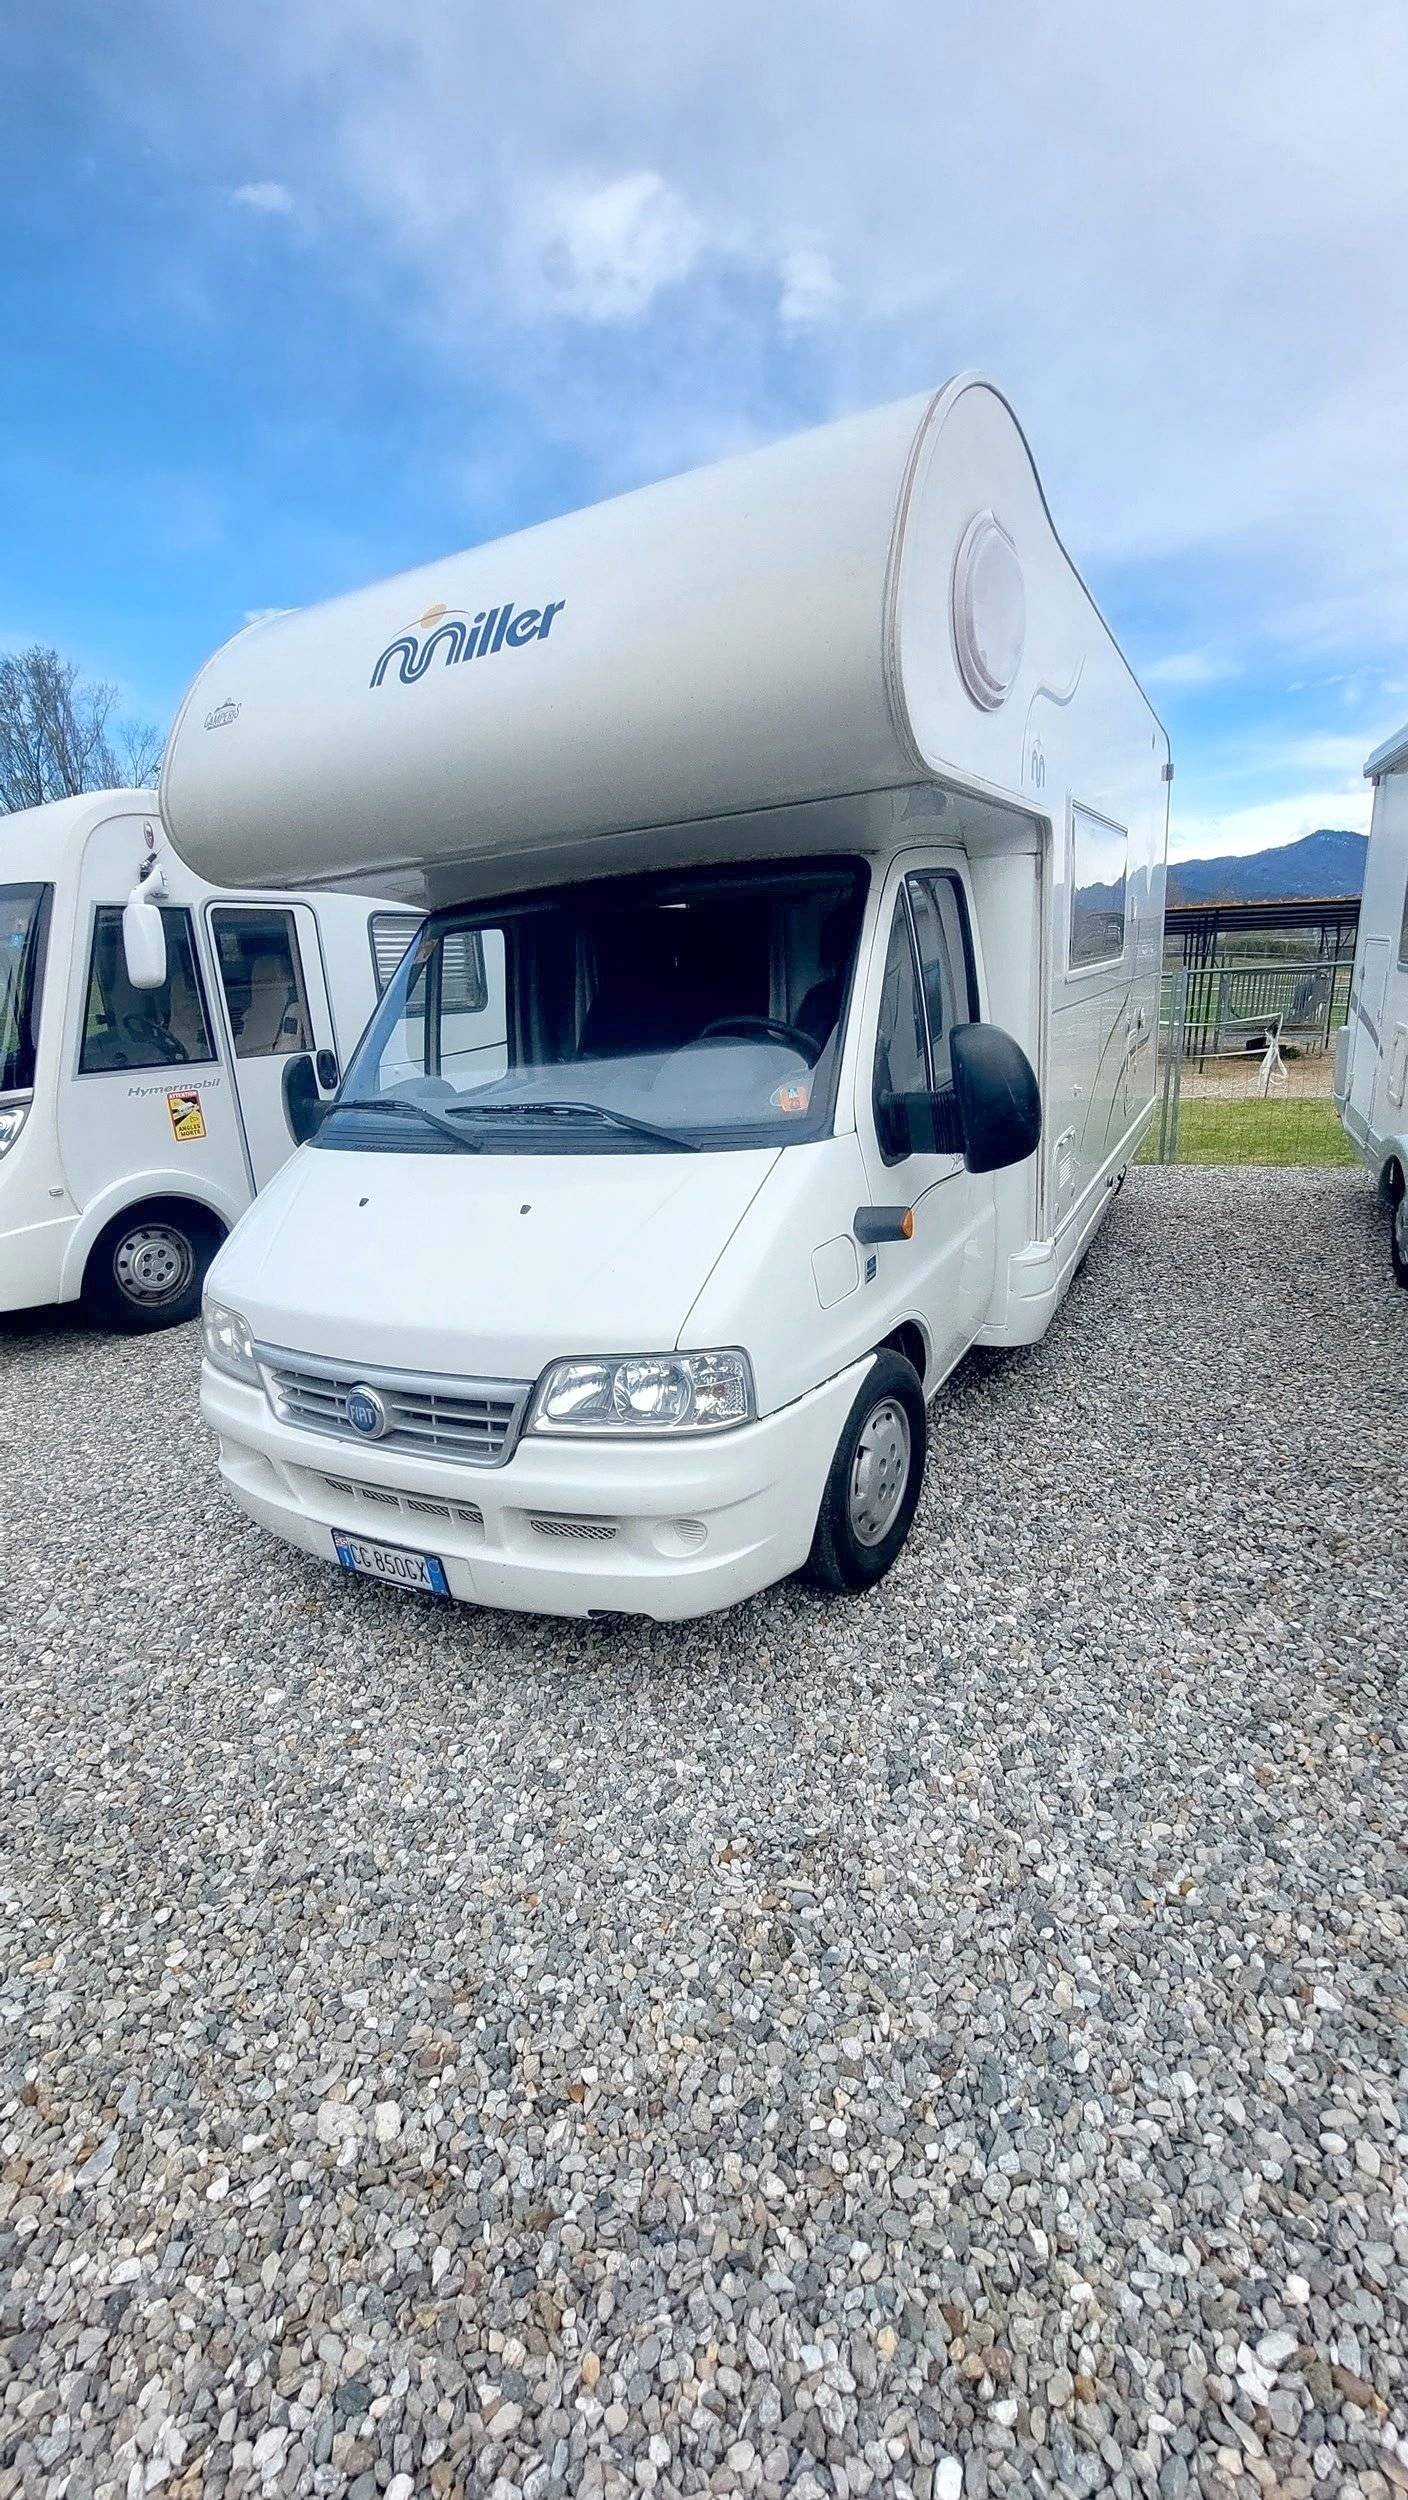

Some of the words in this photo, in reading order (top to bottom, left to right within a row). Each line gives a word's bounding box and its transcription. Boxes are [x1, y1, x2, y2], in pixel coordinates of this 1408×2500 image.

[128, 1078, 220, 1097] Hymermobil
[178, 1123, 201, 1132] ANGLES
[350, 1404, 373, 1424] FIAT
